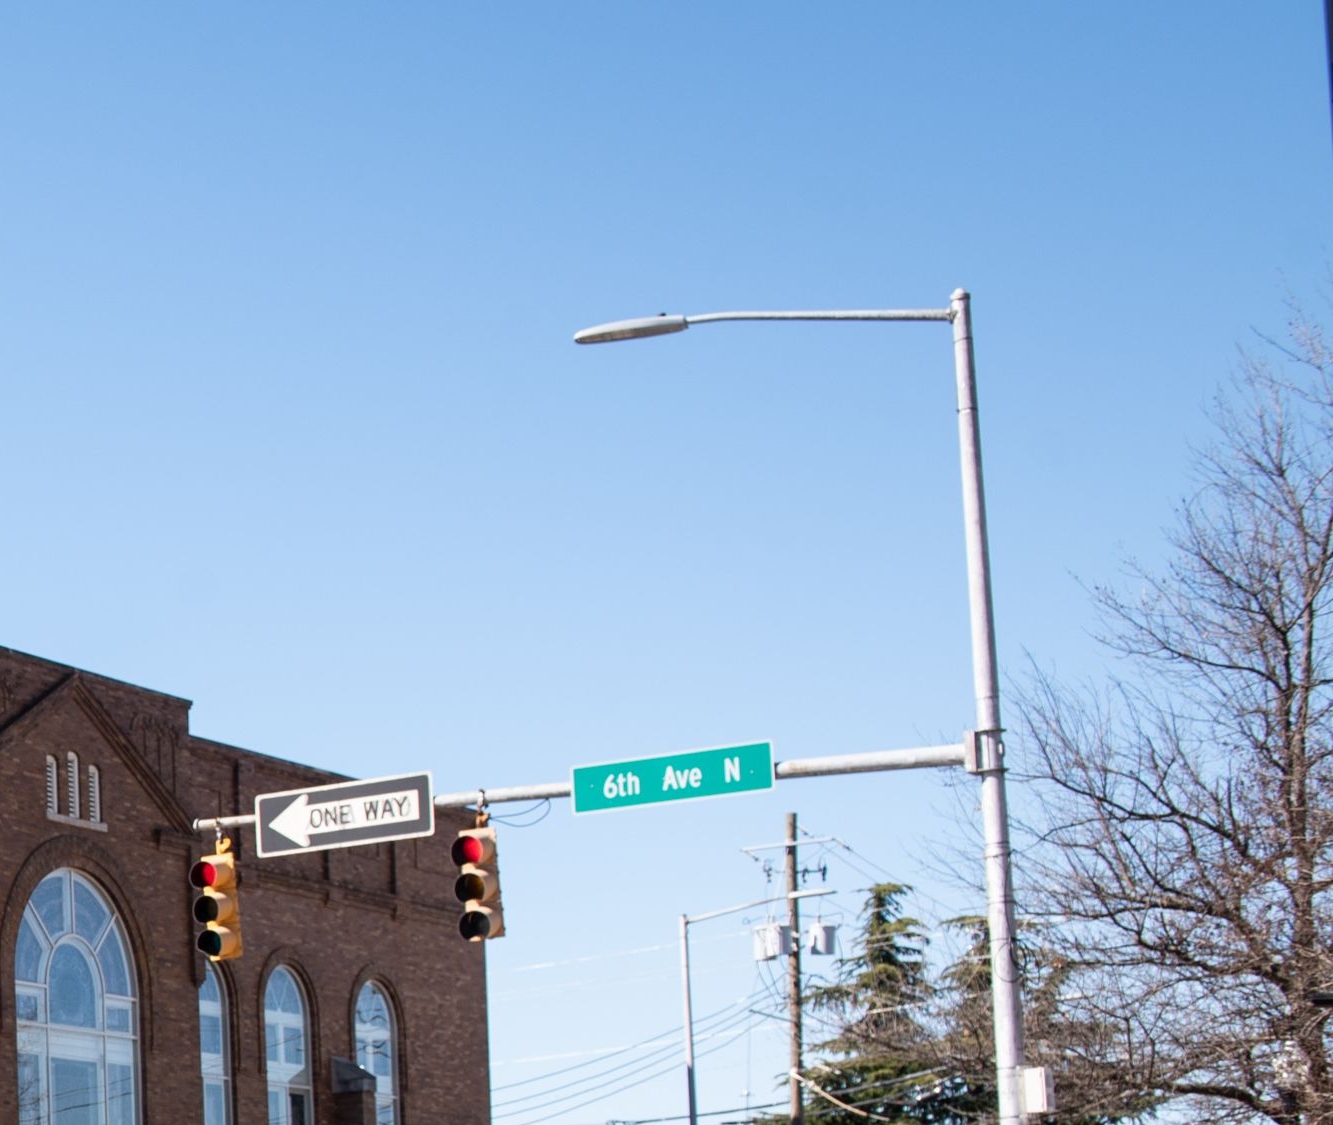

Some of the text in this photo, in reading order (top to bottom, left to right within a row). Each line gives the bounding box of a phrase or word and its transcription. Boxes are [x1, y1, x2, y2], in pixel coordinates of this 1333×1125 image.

[603, 756, 741, 799] 6th Ave N
[310, 796, 408, 828] ONE WAY
